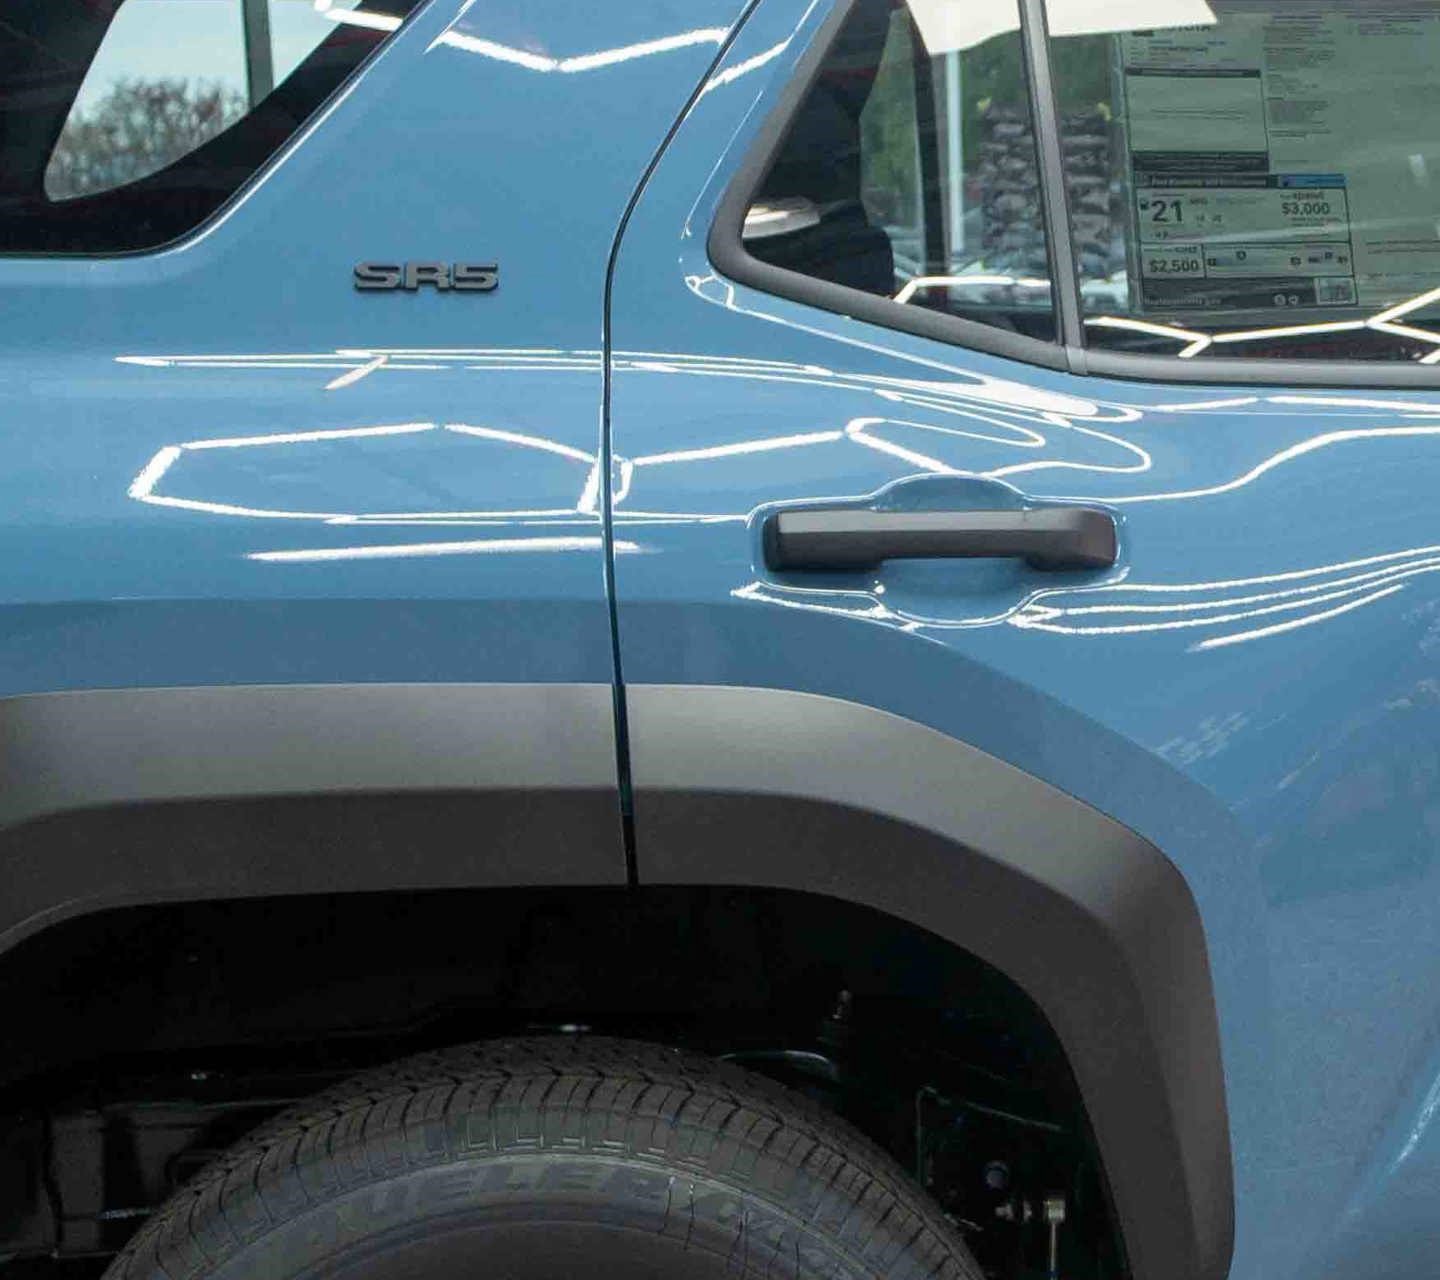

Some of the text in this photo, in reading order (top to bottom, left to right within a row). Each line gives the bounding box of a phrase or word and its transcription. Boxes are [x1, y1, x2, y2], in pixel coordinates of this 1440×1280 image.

[1151, 200, 1183, 222] 21
[353, 263, 499, 291] SR5
[1149, 259, 1200, 274] $2,500
